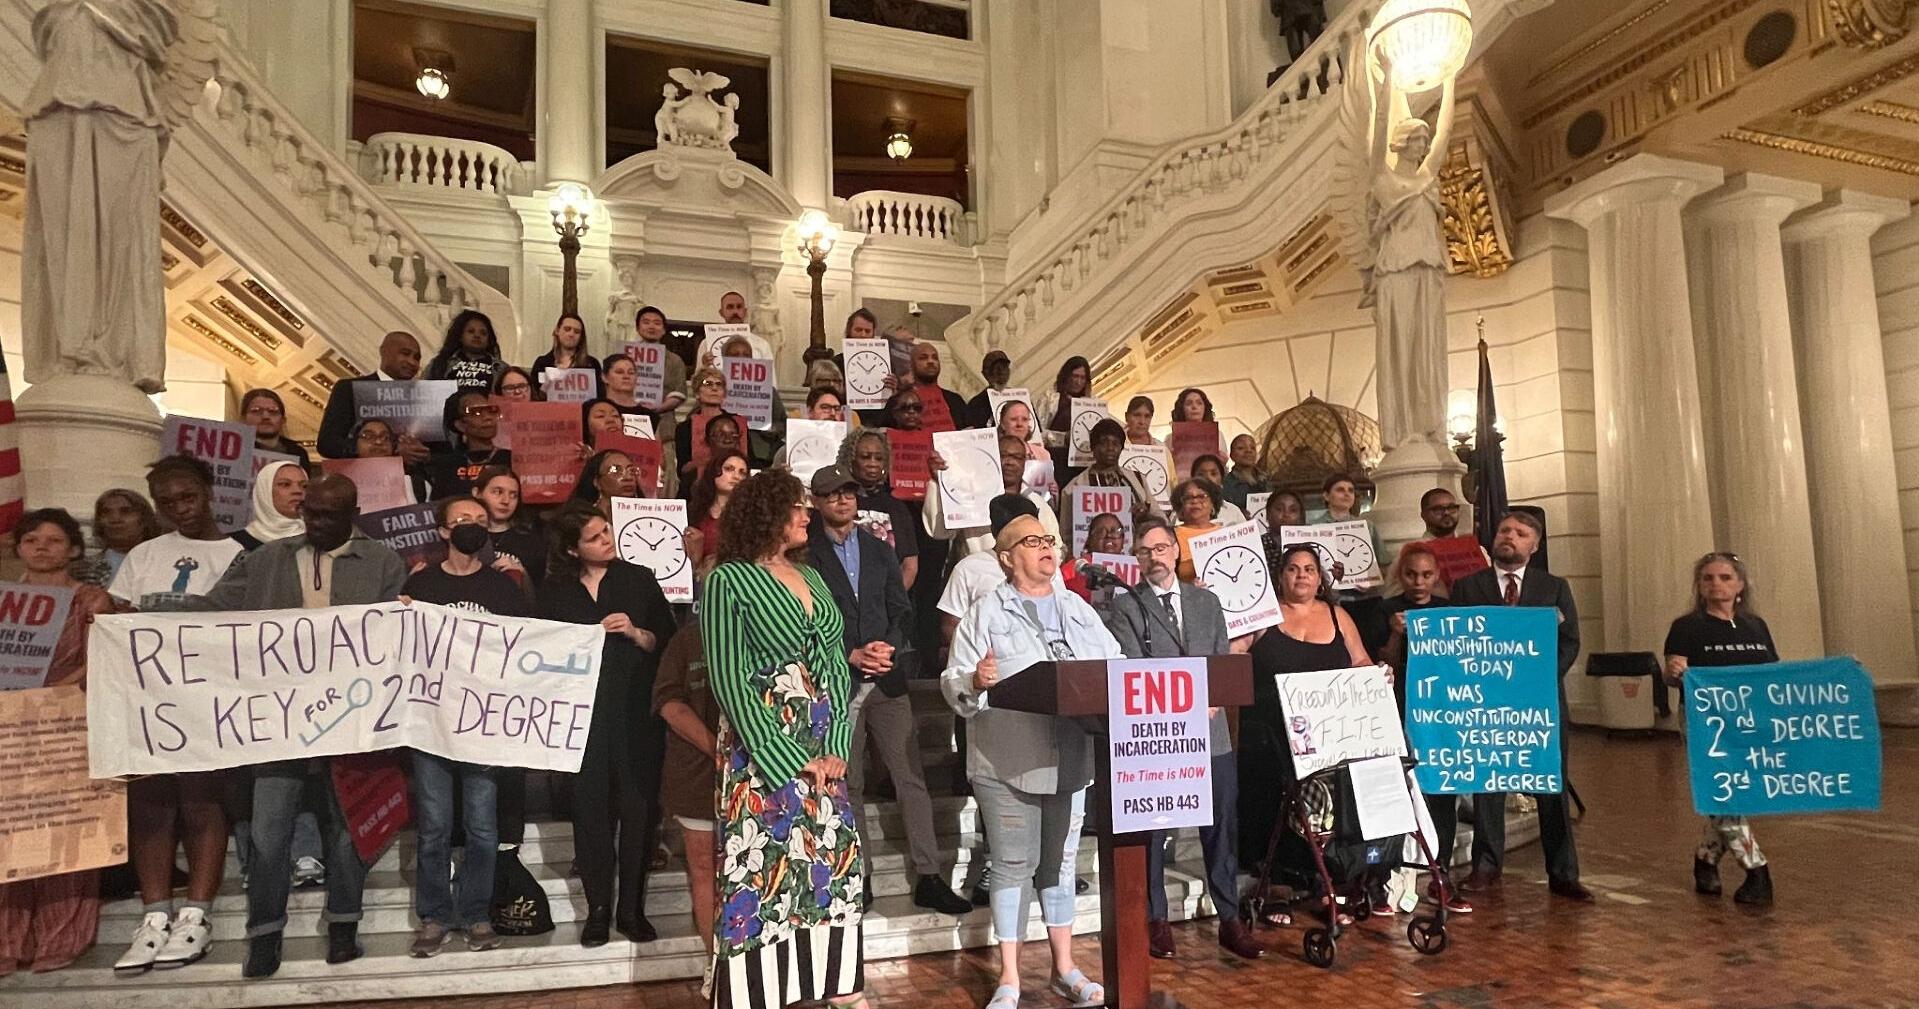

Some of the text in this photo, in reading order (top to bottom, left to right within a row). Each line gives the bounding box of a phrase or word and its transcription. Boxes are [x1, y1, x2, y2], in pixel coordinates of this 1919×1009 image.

[730, 362, 767, 383] END
[176, 423, 243, 461] END
[616, 501, 684, 513] The Time is NOW
[1082, 491, 1124, 512] END
[1193, 525, 1256, 549] The Time is NOW
[661, 586, 690, 595] OUNTING
[0, 590, 56, 626] ND
[1413, 615, 1486, 636] IF IT IS
[18, 630, 36, 643] BY
[130, 608, 523, 690] RETROACTIVITY
[1124, 670, 1194, 716] END
[1417, 675, 1484, 703] IT WAS
[1694, 683, 1850, 712] STOP GIVING
[140, 672, 590, 755] IS KEY FOR 2nd DEGREE
[1131, 721, 1187, 738] DEATH BY
[1457, 728, 1551, 749] YESTERDAY
[1706, 709, 1864, 758] 2nd DEGREE
[1114, 738, 1207, 758] INCARCERATION
[1414, 747, 1532, 768] LEGISLATE
[1116, 765, 1206, 783] The Time is NOW
[1439, 765, 1475, 791] 2nd
[1713, 769, 1853, 802] 3rd DEGREE
[1123, 794, 1200, 815] PASS HB 443
